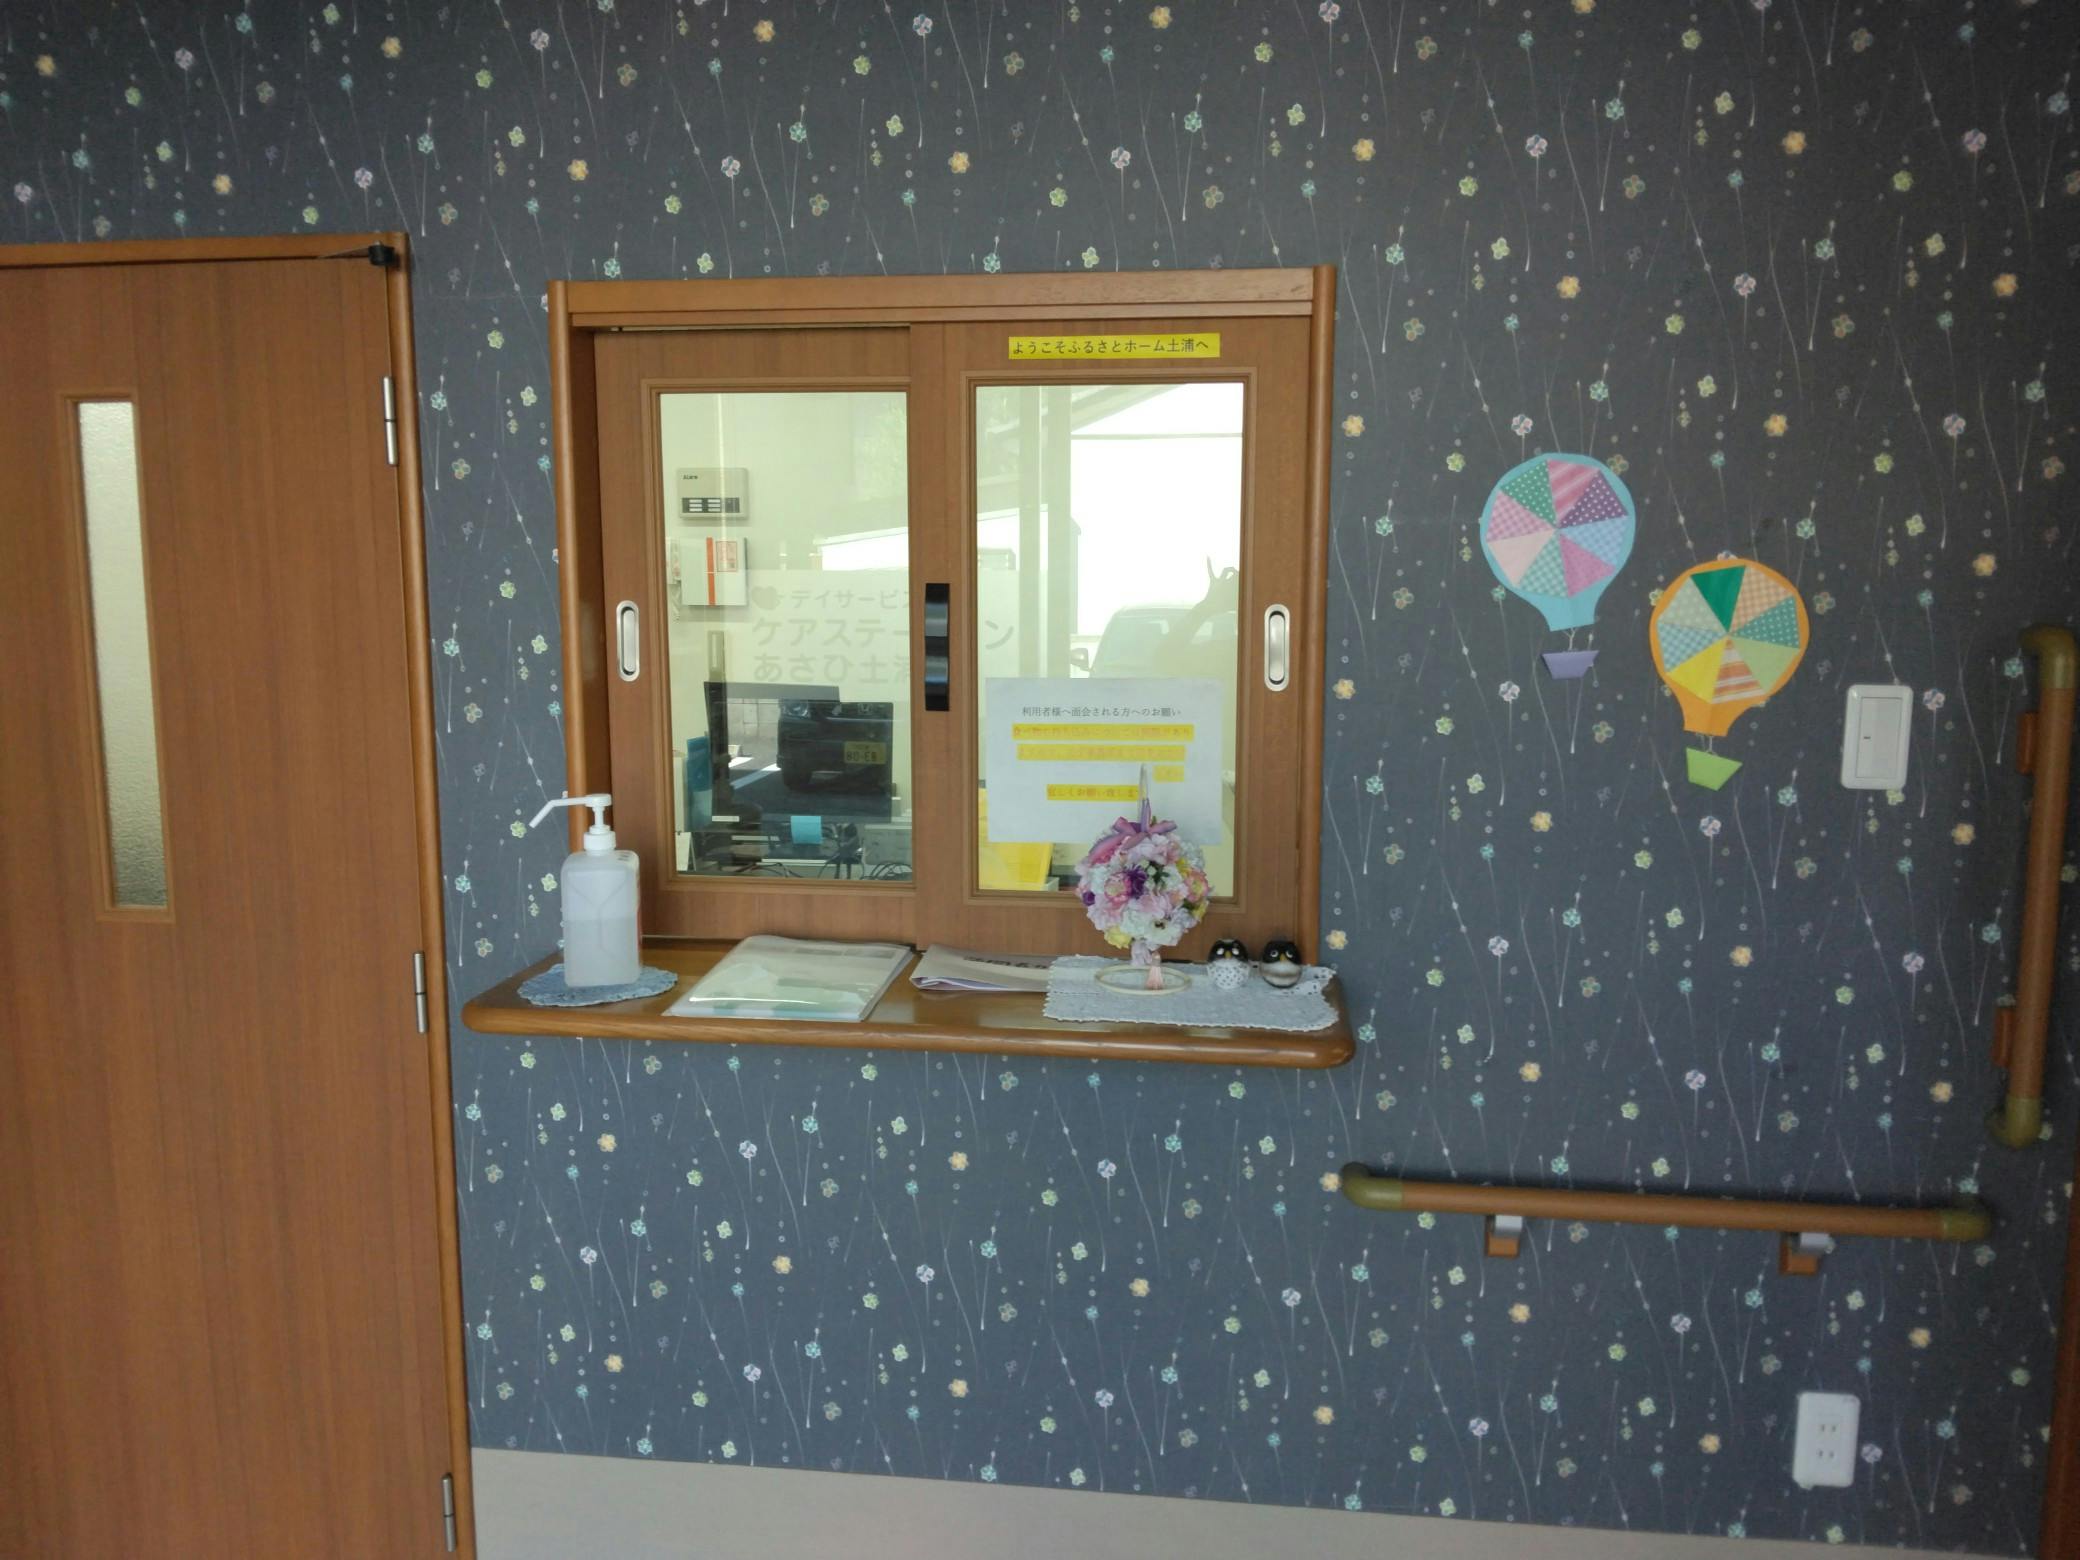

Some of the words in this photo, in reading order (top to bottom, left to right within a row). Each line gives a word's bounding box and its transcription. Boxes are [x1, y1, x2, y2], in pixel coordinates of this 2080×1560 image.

[1012, 338, 1209, 355] ようこそふるさとホーム土浦へ
[1022, 706, 1181, 717] 利用者様へ面会される方へのお願い
[1047, 786, 1140, 798] 宜しくお願い致しま
